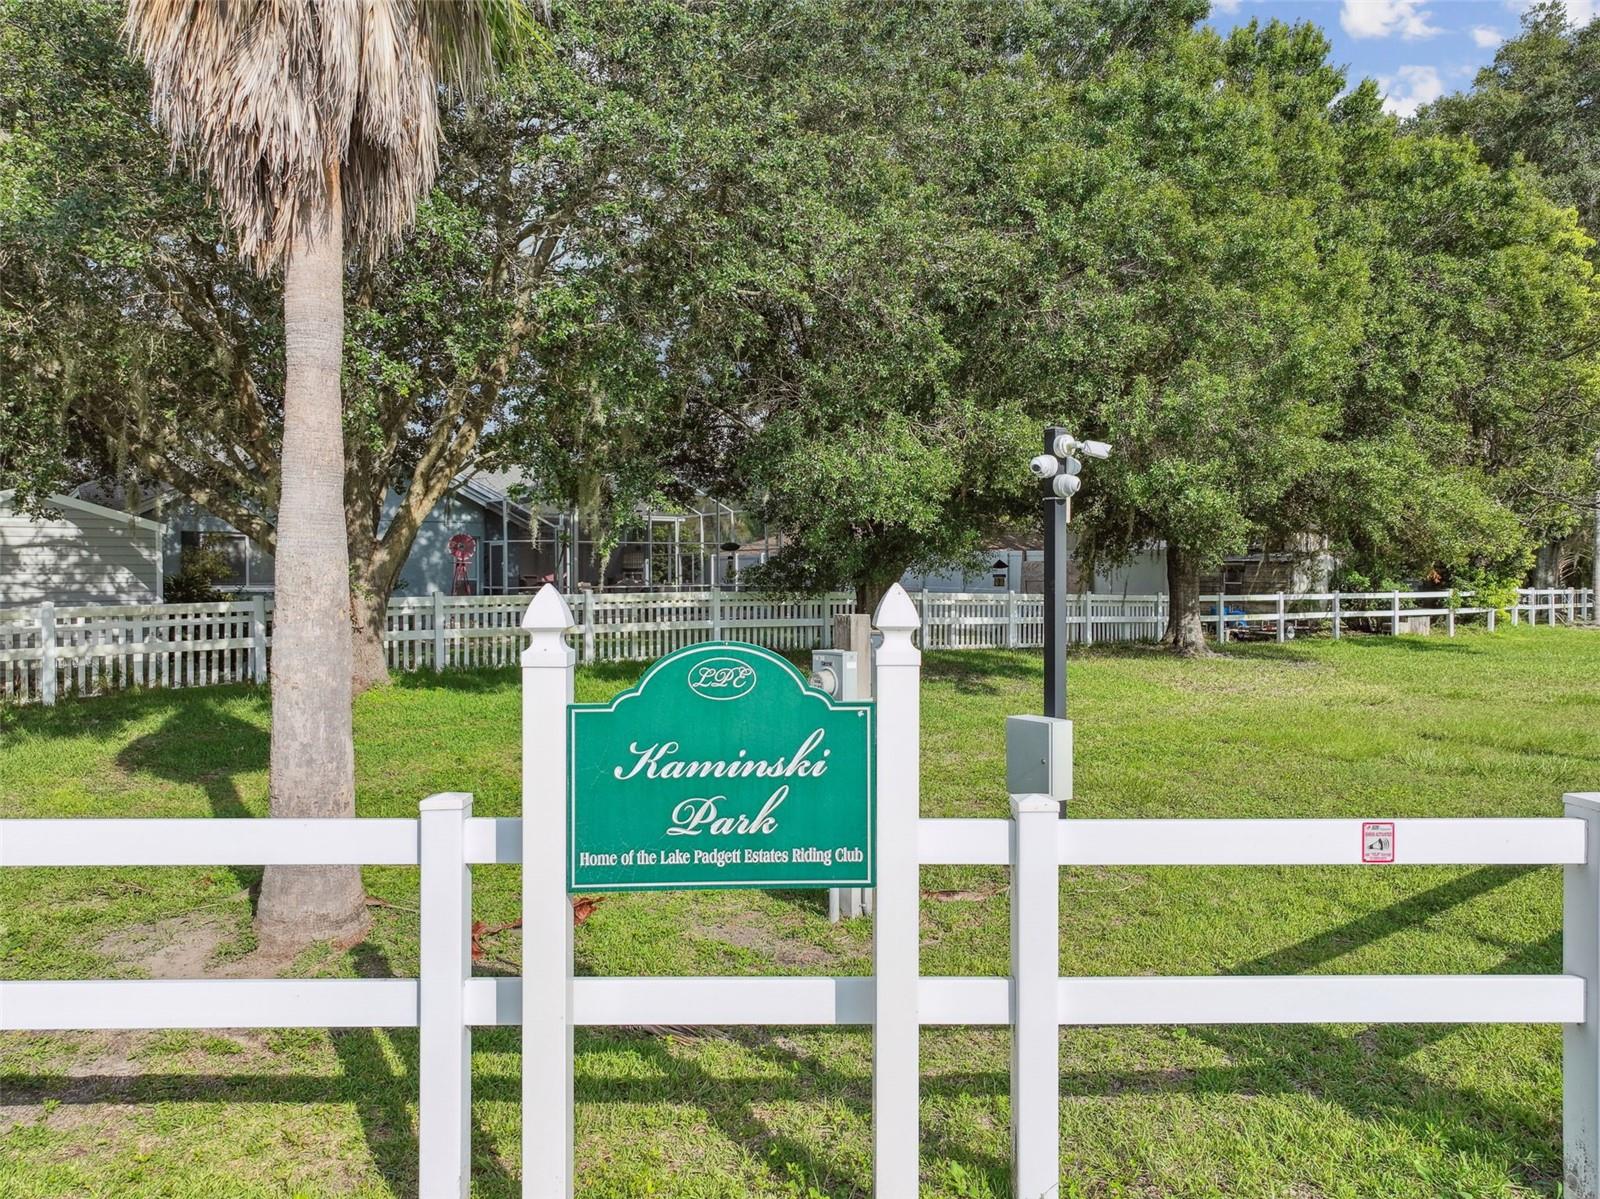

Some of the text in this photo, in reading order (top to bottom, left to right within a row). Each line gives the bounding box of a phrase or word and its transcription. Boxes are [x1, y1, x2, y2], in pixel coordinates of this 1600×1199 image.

[613, 727, 831, 780] Kaminski
[665, 784, 790, 836] Park
[579, 846, 864, 868] Home of the Lake Padgett Estates Riding Club
